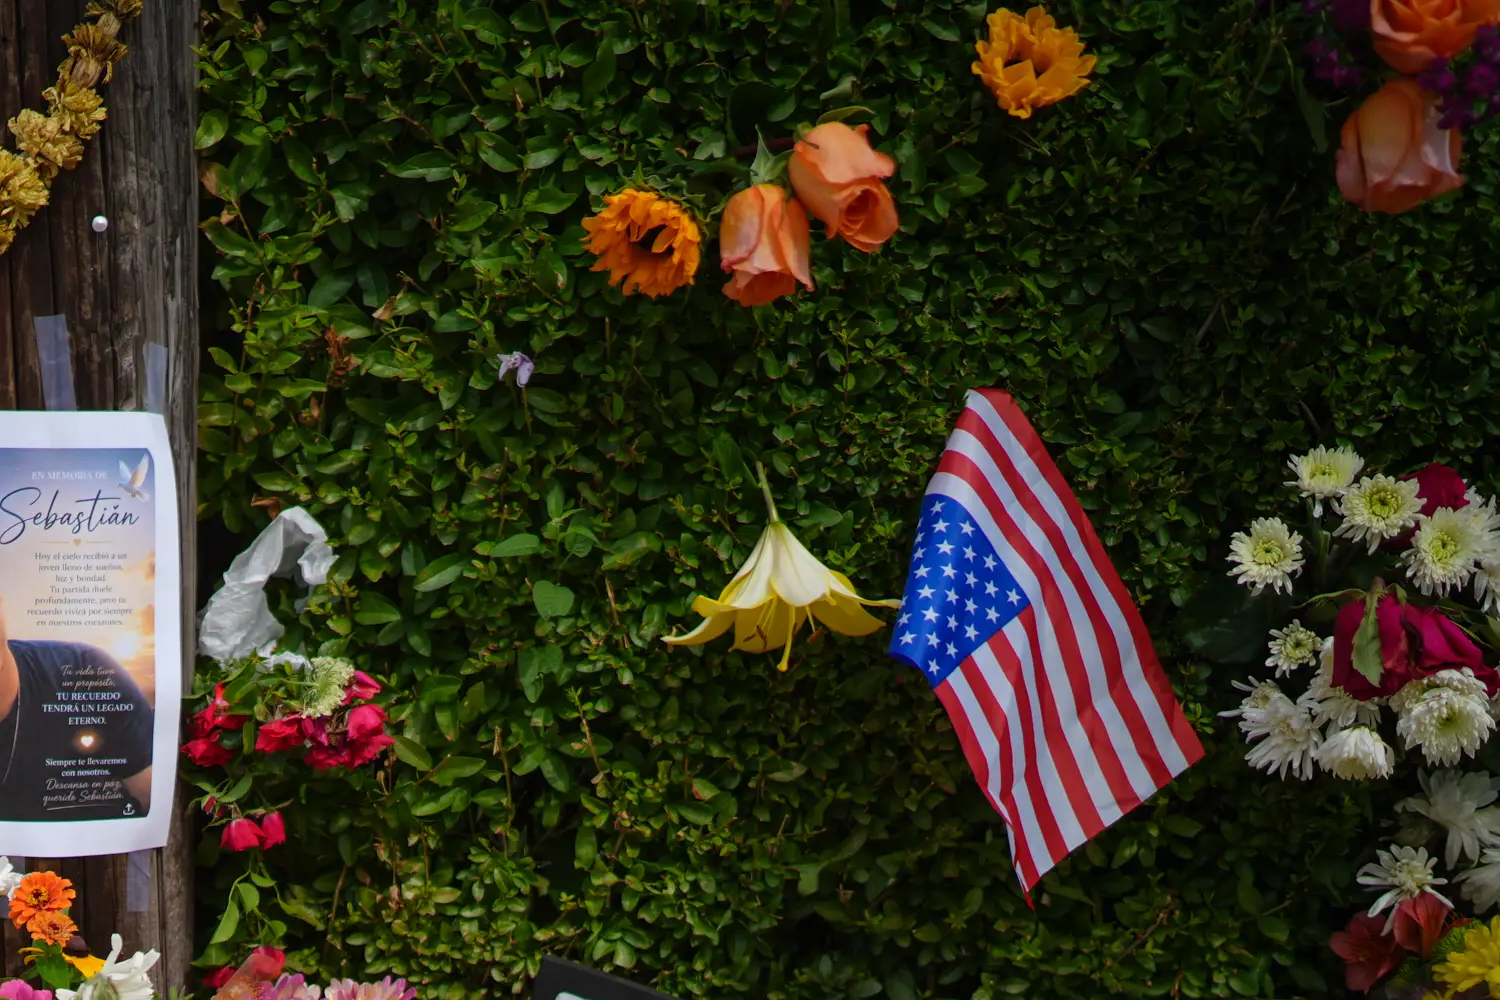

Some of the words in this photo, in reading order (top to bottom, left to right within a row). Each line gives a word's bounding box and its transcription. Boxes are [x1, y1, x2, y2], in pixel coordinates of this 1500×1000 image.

[31, 470, 45, 480] EN
[46, 470, 93, 480] MEMORIA
[95, 470, 109, 480] DE
[34, 552, 51, 561] Hoy
[52, 552, 60, 560] el
[62, 552, 81, 560] cielo
[38, 563, 60, 572] joven
[62, 563, 82, 571] lleno
[83, 563, 93, 571] de
[55, 574, 68, 582] luz
[49, 585, 60, 593] Tu
[62, 585, 90, 595] partida
[92, 585, 113, 593] duele
[99, 598, 116, 606] pero
[27, 608, 62, 616] recuerdo
[88, 609, 101, 617] por
[103, 607, 133, 617] siempre
[48, 619, 82, 627] nuestros
[61, 664, 73, 676] Tu
[75, 664, 95, 676] vida
[96, 666, 116, 676] tuvo
[56, 692, 69, 701] TU
[71, 691, 121, 701] RECUERDO
[42, 702, 80, 713] TENDRÁ
[81, 704, 95, 713] UN
[96, 703, 134, 712] LEGADO
[68, 716, 107, 725] ETERNO.
[45, 758, 77, 768] Siempre
[86, 757, 127, 766] llevaremos
[76, 768, 111, 777] nosotros.
[45, 778, 90, 791] Descansa
[42, 790, 77, 807] querido
